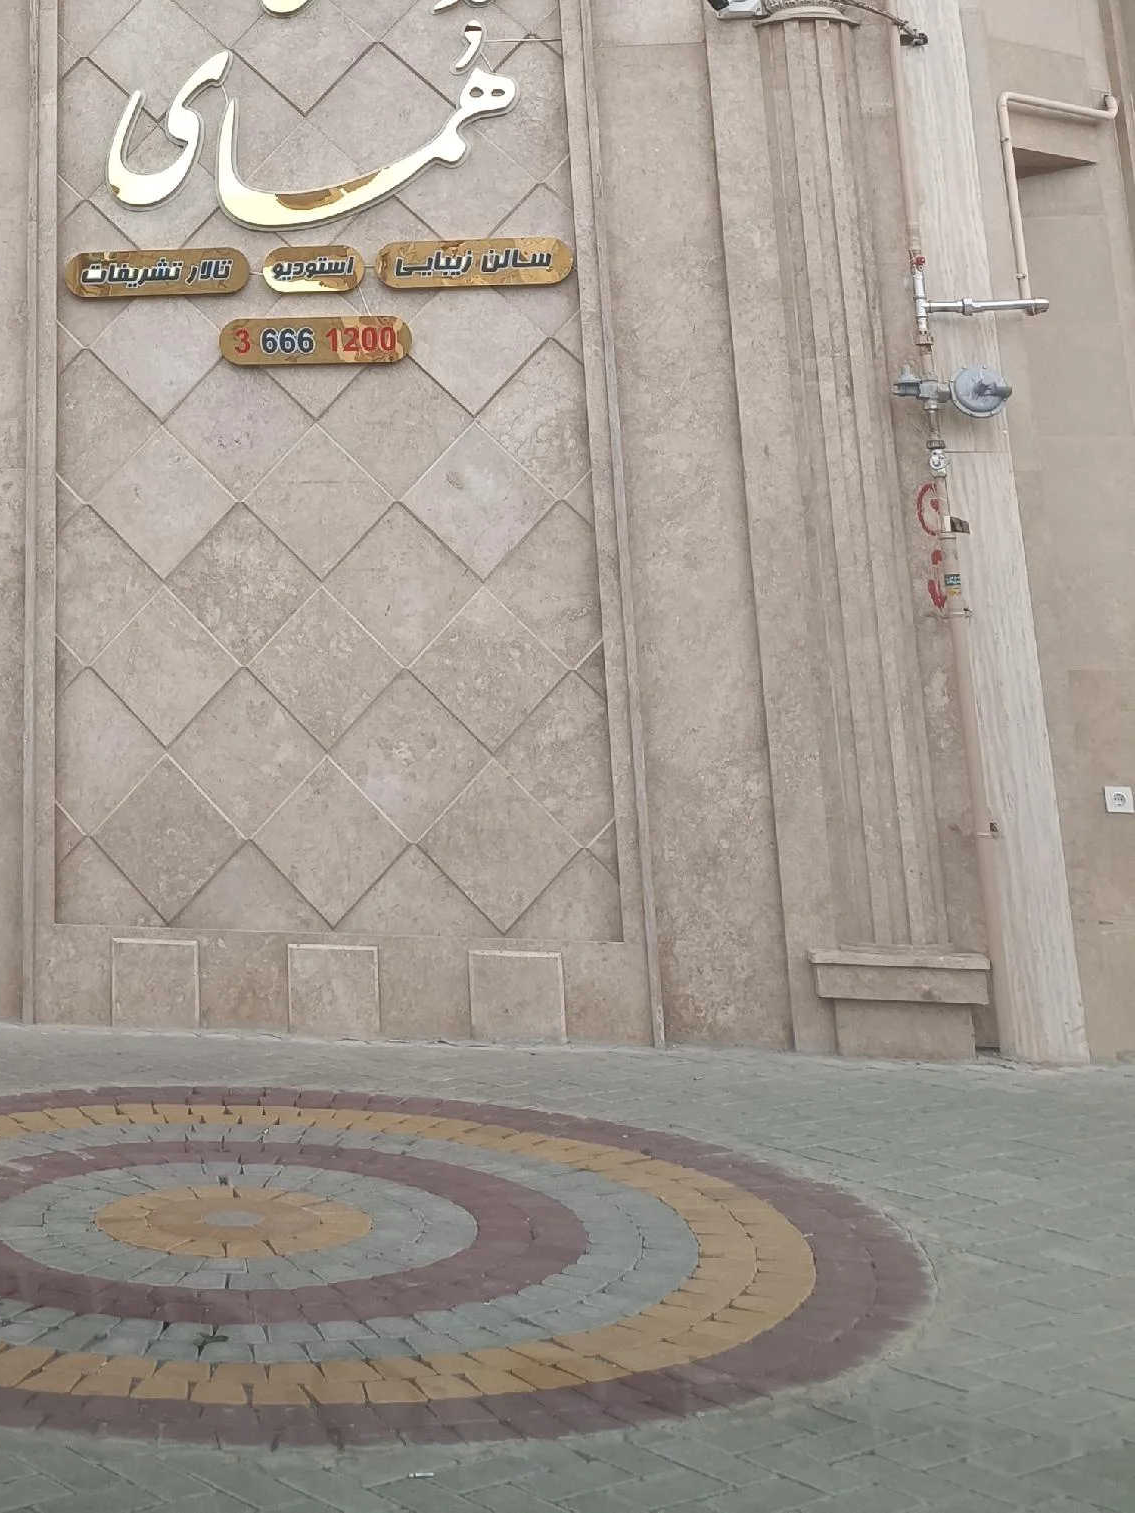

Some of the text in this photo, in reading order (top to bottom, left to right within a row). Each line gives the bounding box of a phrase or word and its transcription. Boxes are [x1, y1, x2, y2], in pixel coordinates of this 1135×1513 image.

[79, 258, 233, 287] تالار تشریفات
[270, 256, 355, 279] استودیو
[394, 247, 554, 277] سالن زیبایی
[233, 326, 398, 354] 3 666 1200
